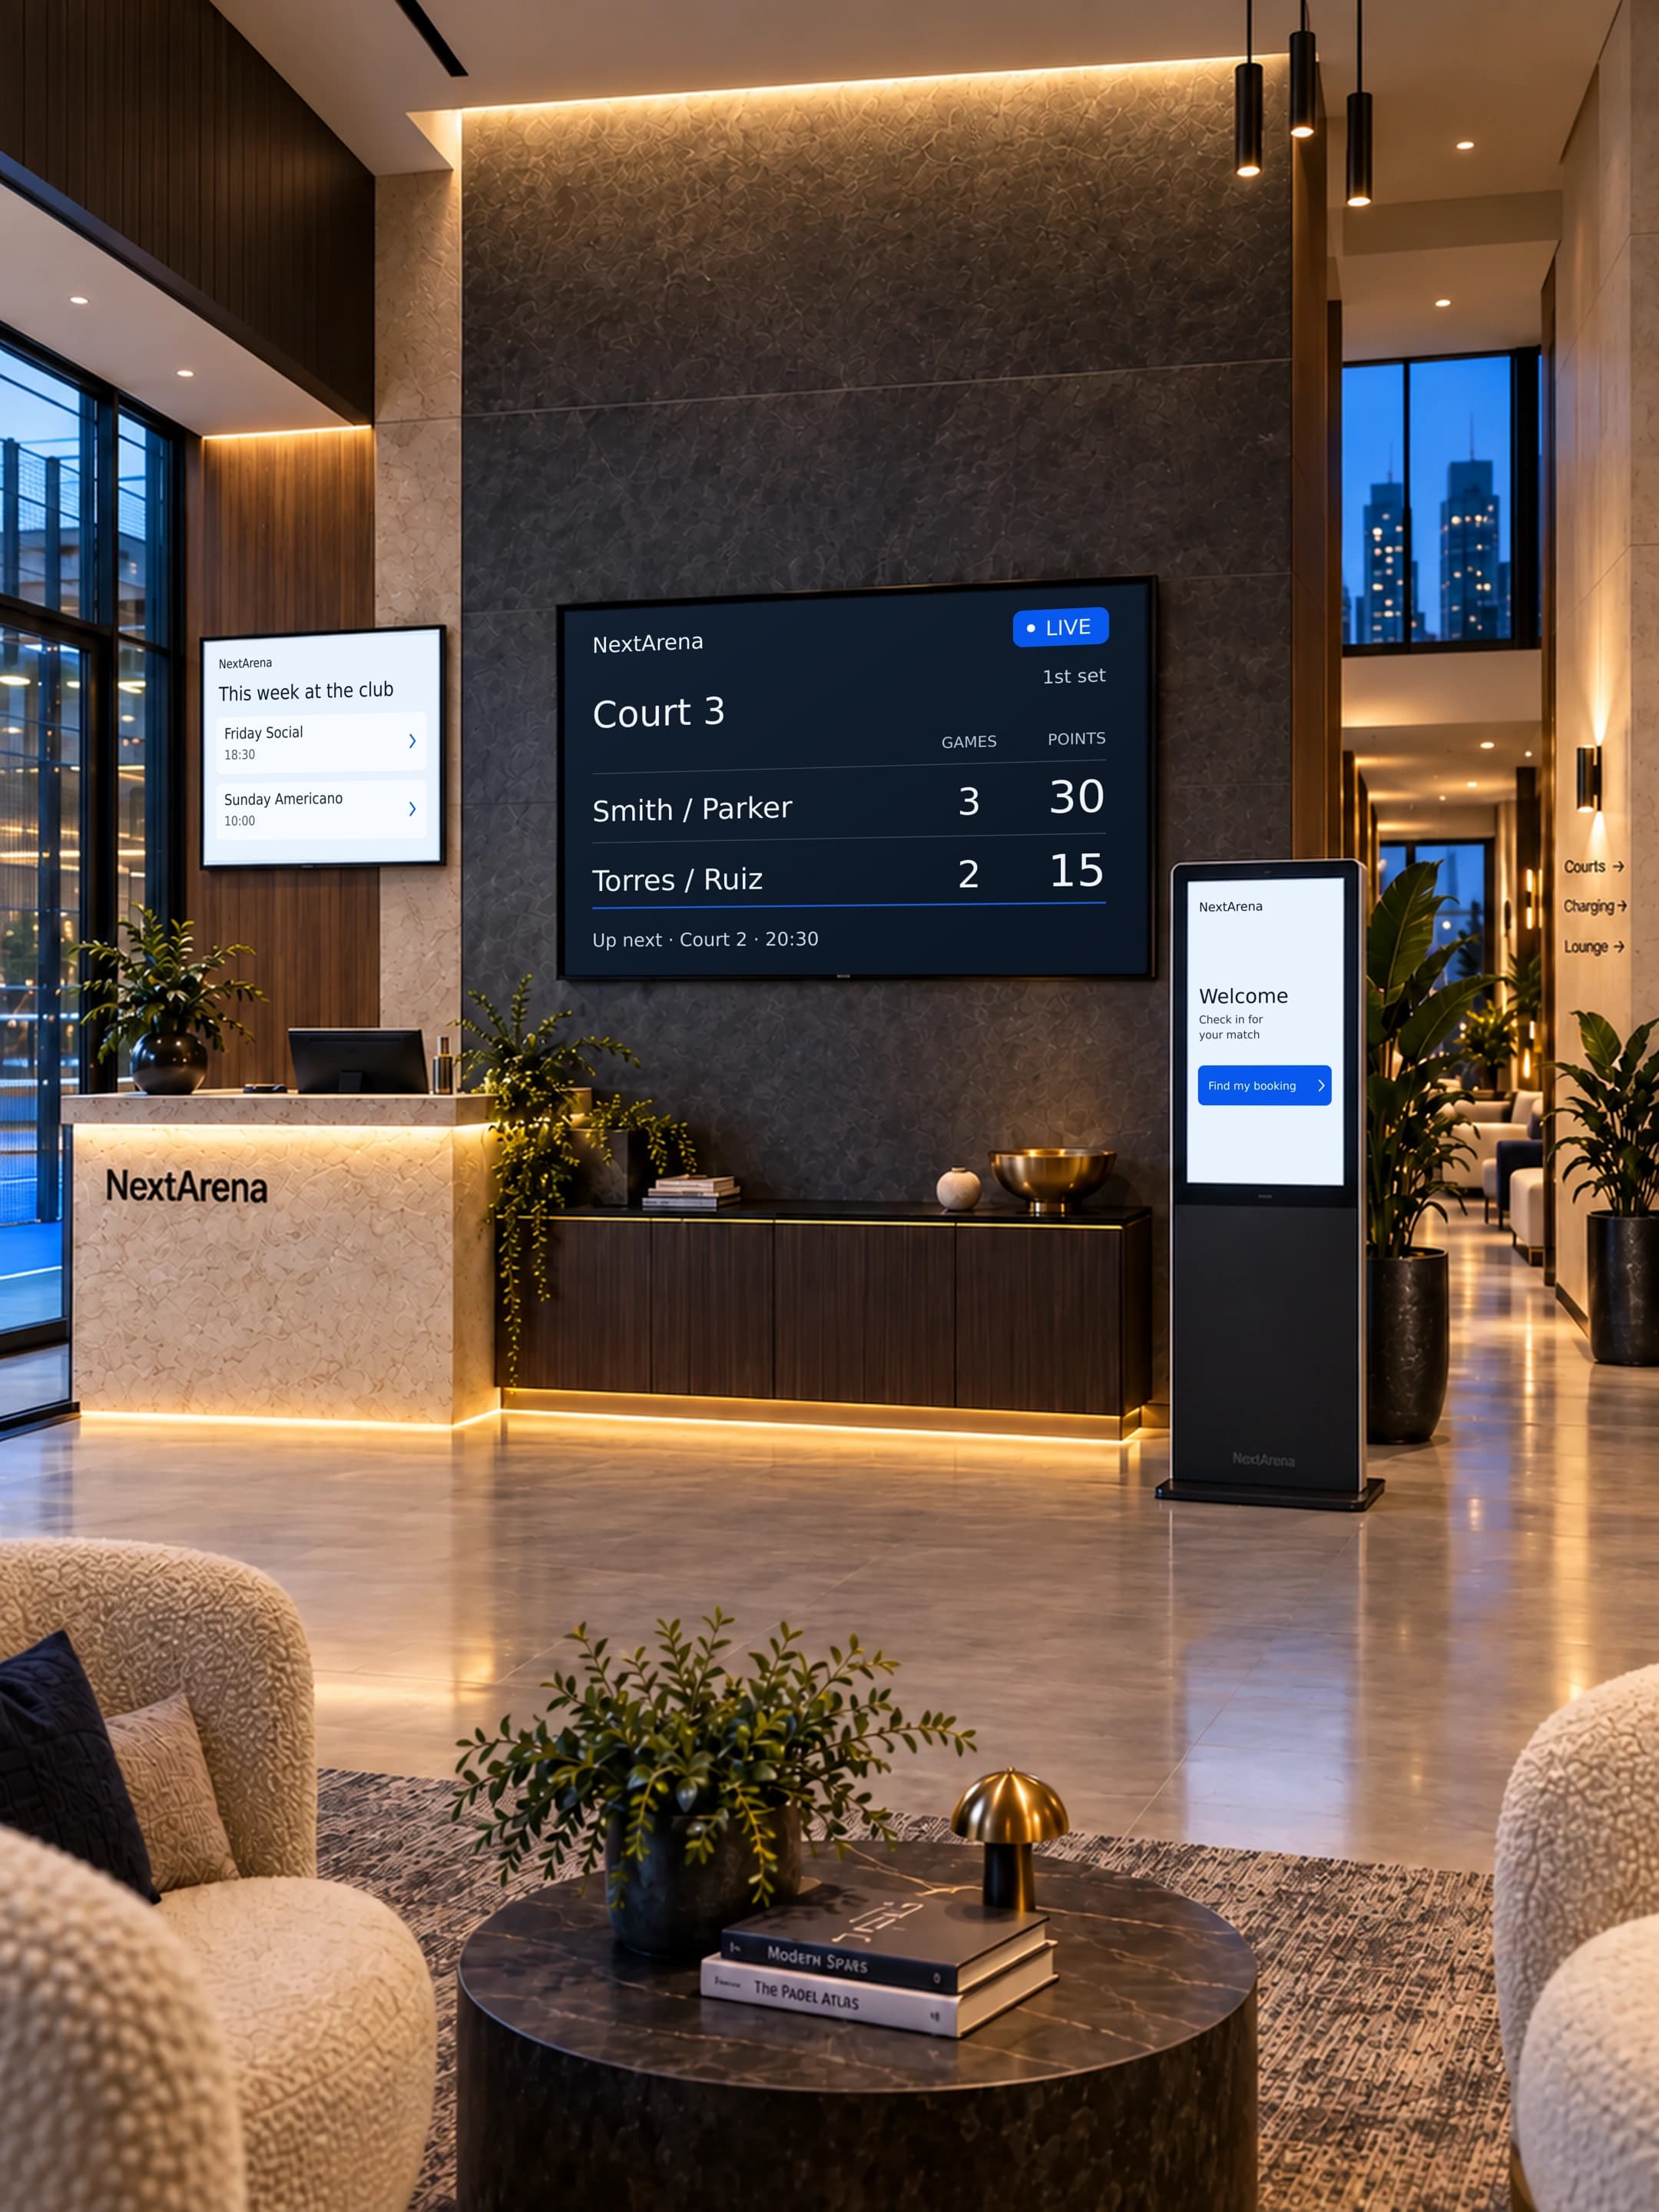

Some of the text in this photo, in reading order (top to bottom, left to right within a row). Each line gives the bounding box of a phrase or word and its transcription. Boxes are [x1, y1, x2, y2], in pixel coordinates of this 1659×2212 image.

[1048, 618, 1091, 635] LIVE
[594, 634, 702, 653] NextArena
[220, 658, 272, 669] NextArena
[1045, 669, 1106, 684] 1st set
[219, 680, 393, 701] This week at the club
[594, 697, 724, 728] Court 3
[225, 725, 303, 742] Friday Social
[942, 735, 996, 748] GAMES
[1049, 732, 1105, 745] POINTS
[225, 749, 255, 760] 18:30
[225, 793, 343, 808] Sunday Americano
[960, 787, 979, 815] 3
[1051, 779, 1103, 813] 30
[594, 796, 793, 823] Smith / Parker
[225, 816, 255, 826] 10:00
[960, 860, 978, 888] 2
[1052, 853, 1102, 886] 15
[1565, 860, 1605, 873] Courts
[592, 867, 762, 892] Torres / Ruiz
[1200, 902, 1262, 912] NextArena
[1565, 899, 1614, 916] Charging
[594, 933, 616, 951] Up
[624, 933, 662, 947] next
[680, 932, 730, 946] Court
[737, 932, 746, 946] 2
[767, 932, 818, 946] 20:30
[1565, 940, 1608, 956] Lounge
[1200, 988, 1287, 1004] Welcome
[1200, 1015, 1263, 1024] Check in for
[1200, 1030, 1260, 1041] your match
[1209, 1081, 1296, 1092] Find my booking
[107, 1169, 267, 1203] NextArena
[754, 1980, 777, 1997] The
